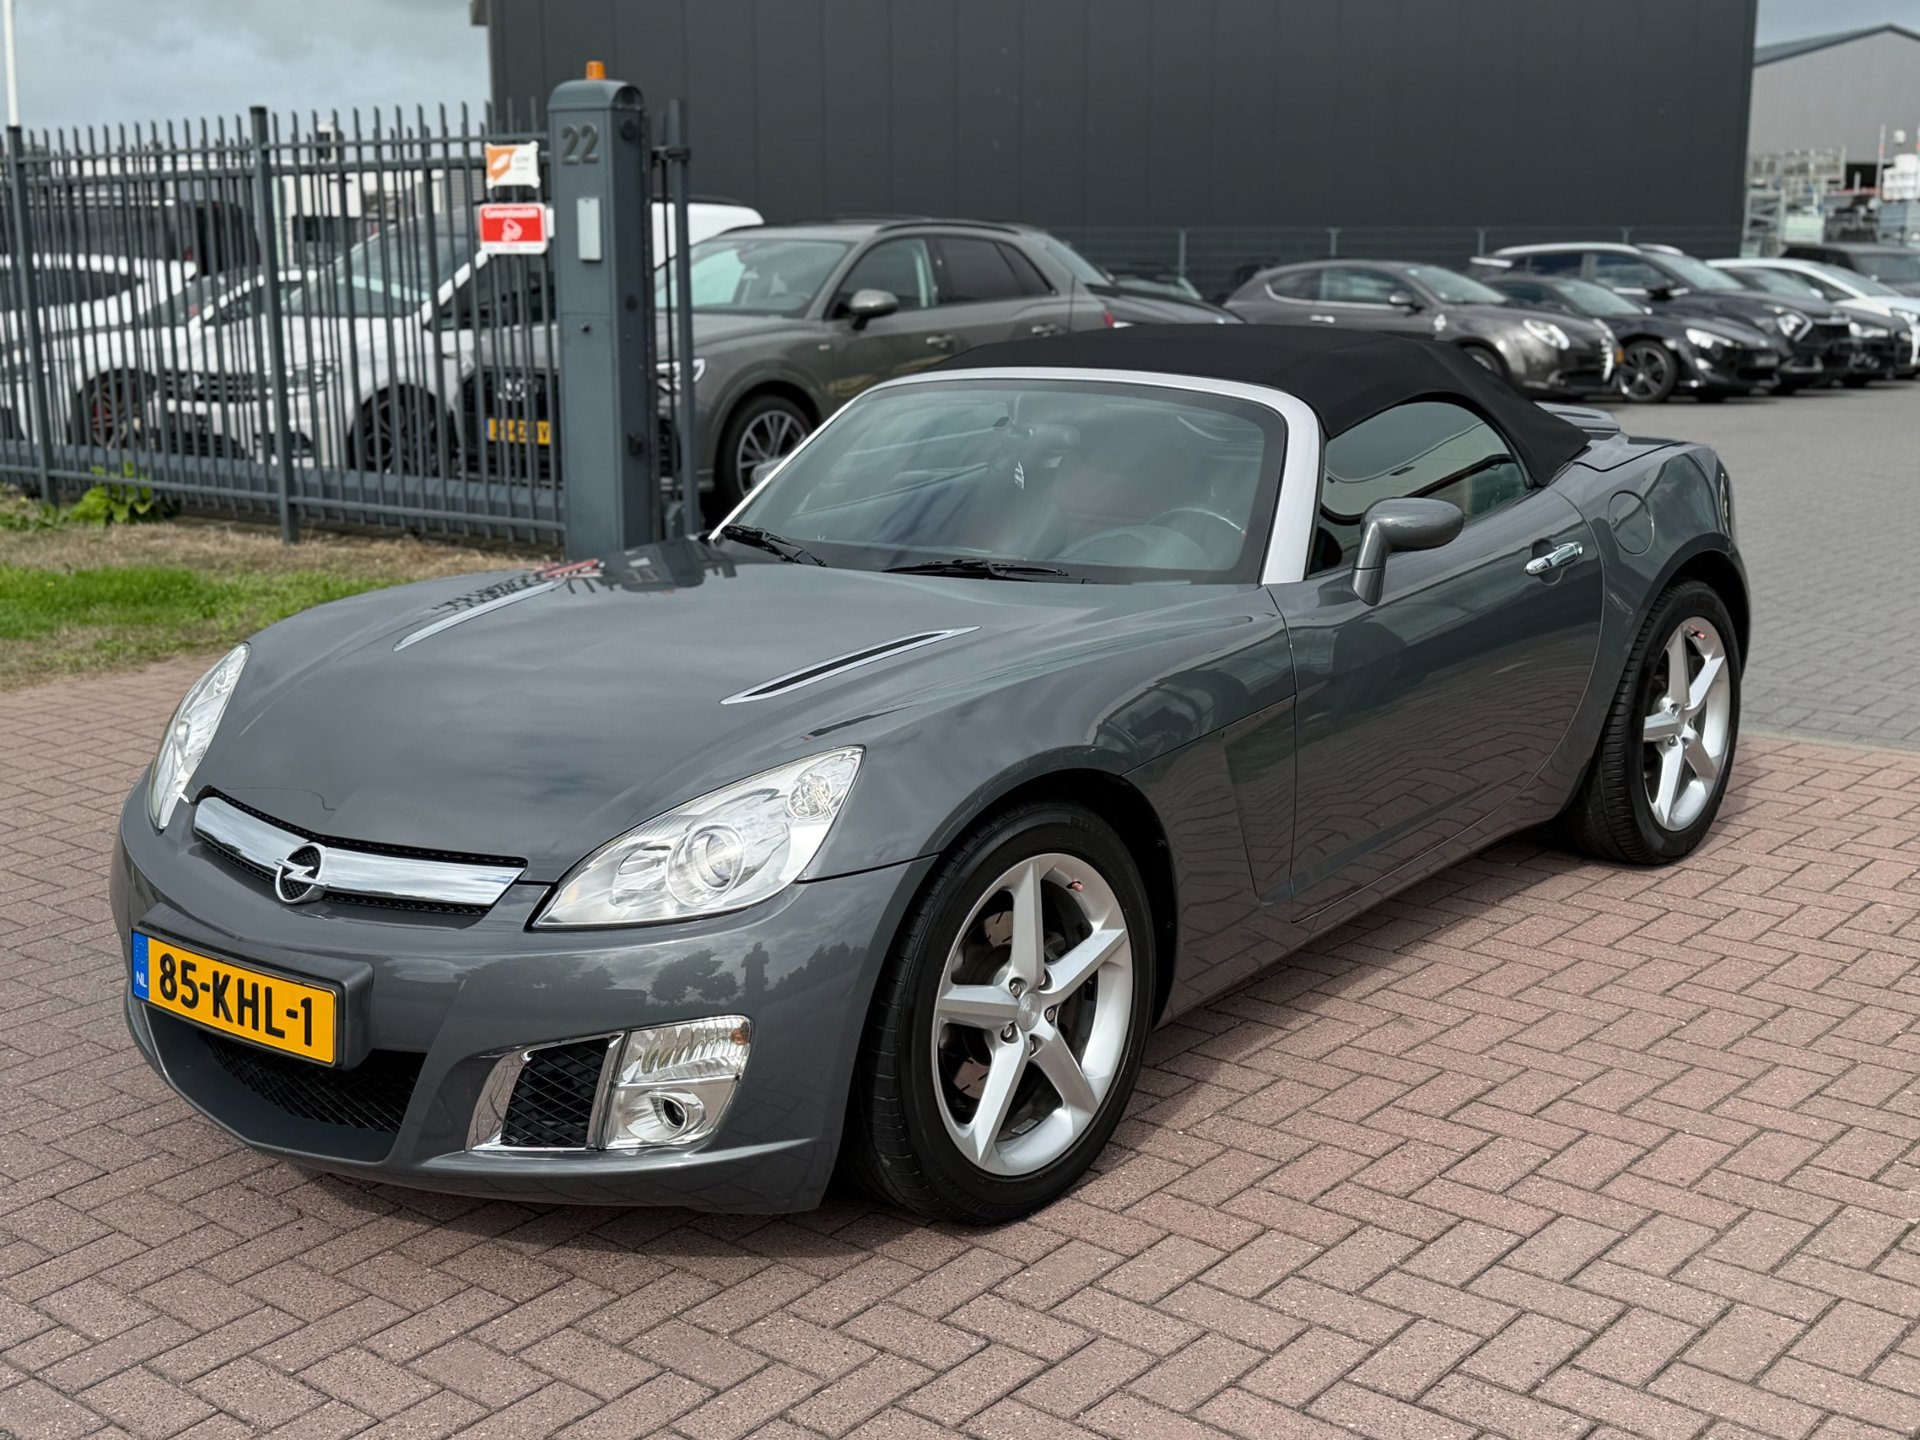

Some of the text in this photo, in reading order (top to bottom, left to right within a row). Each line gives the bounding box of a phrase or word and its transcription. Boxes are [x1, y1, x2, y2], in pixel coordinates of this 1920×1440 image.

[562, 122, 599, 165] 22
[136, 971, 147, 988] NL
[159, 953, 312, 1047] 85-KHL-1
